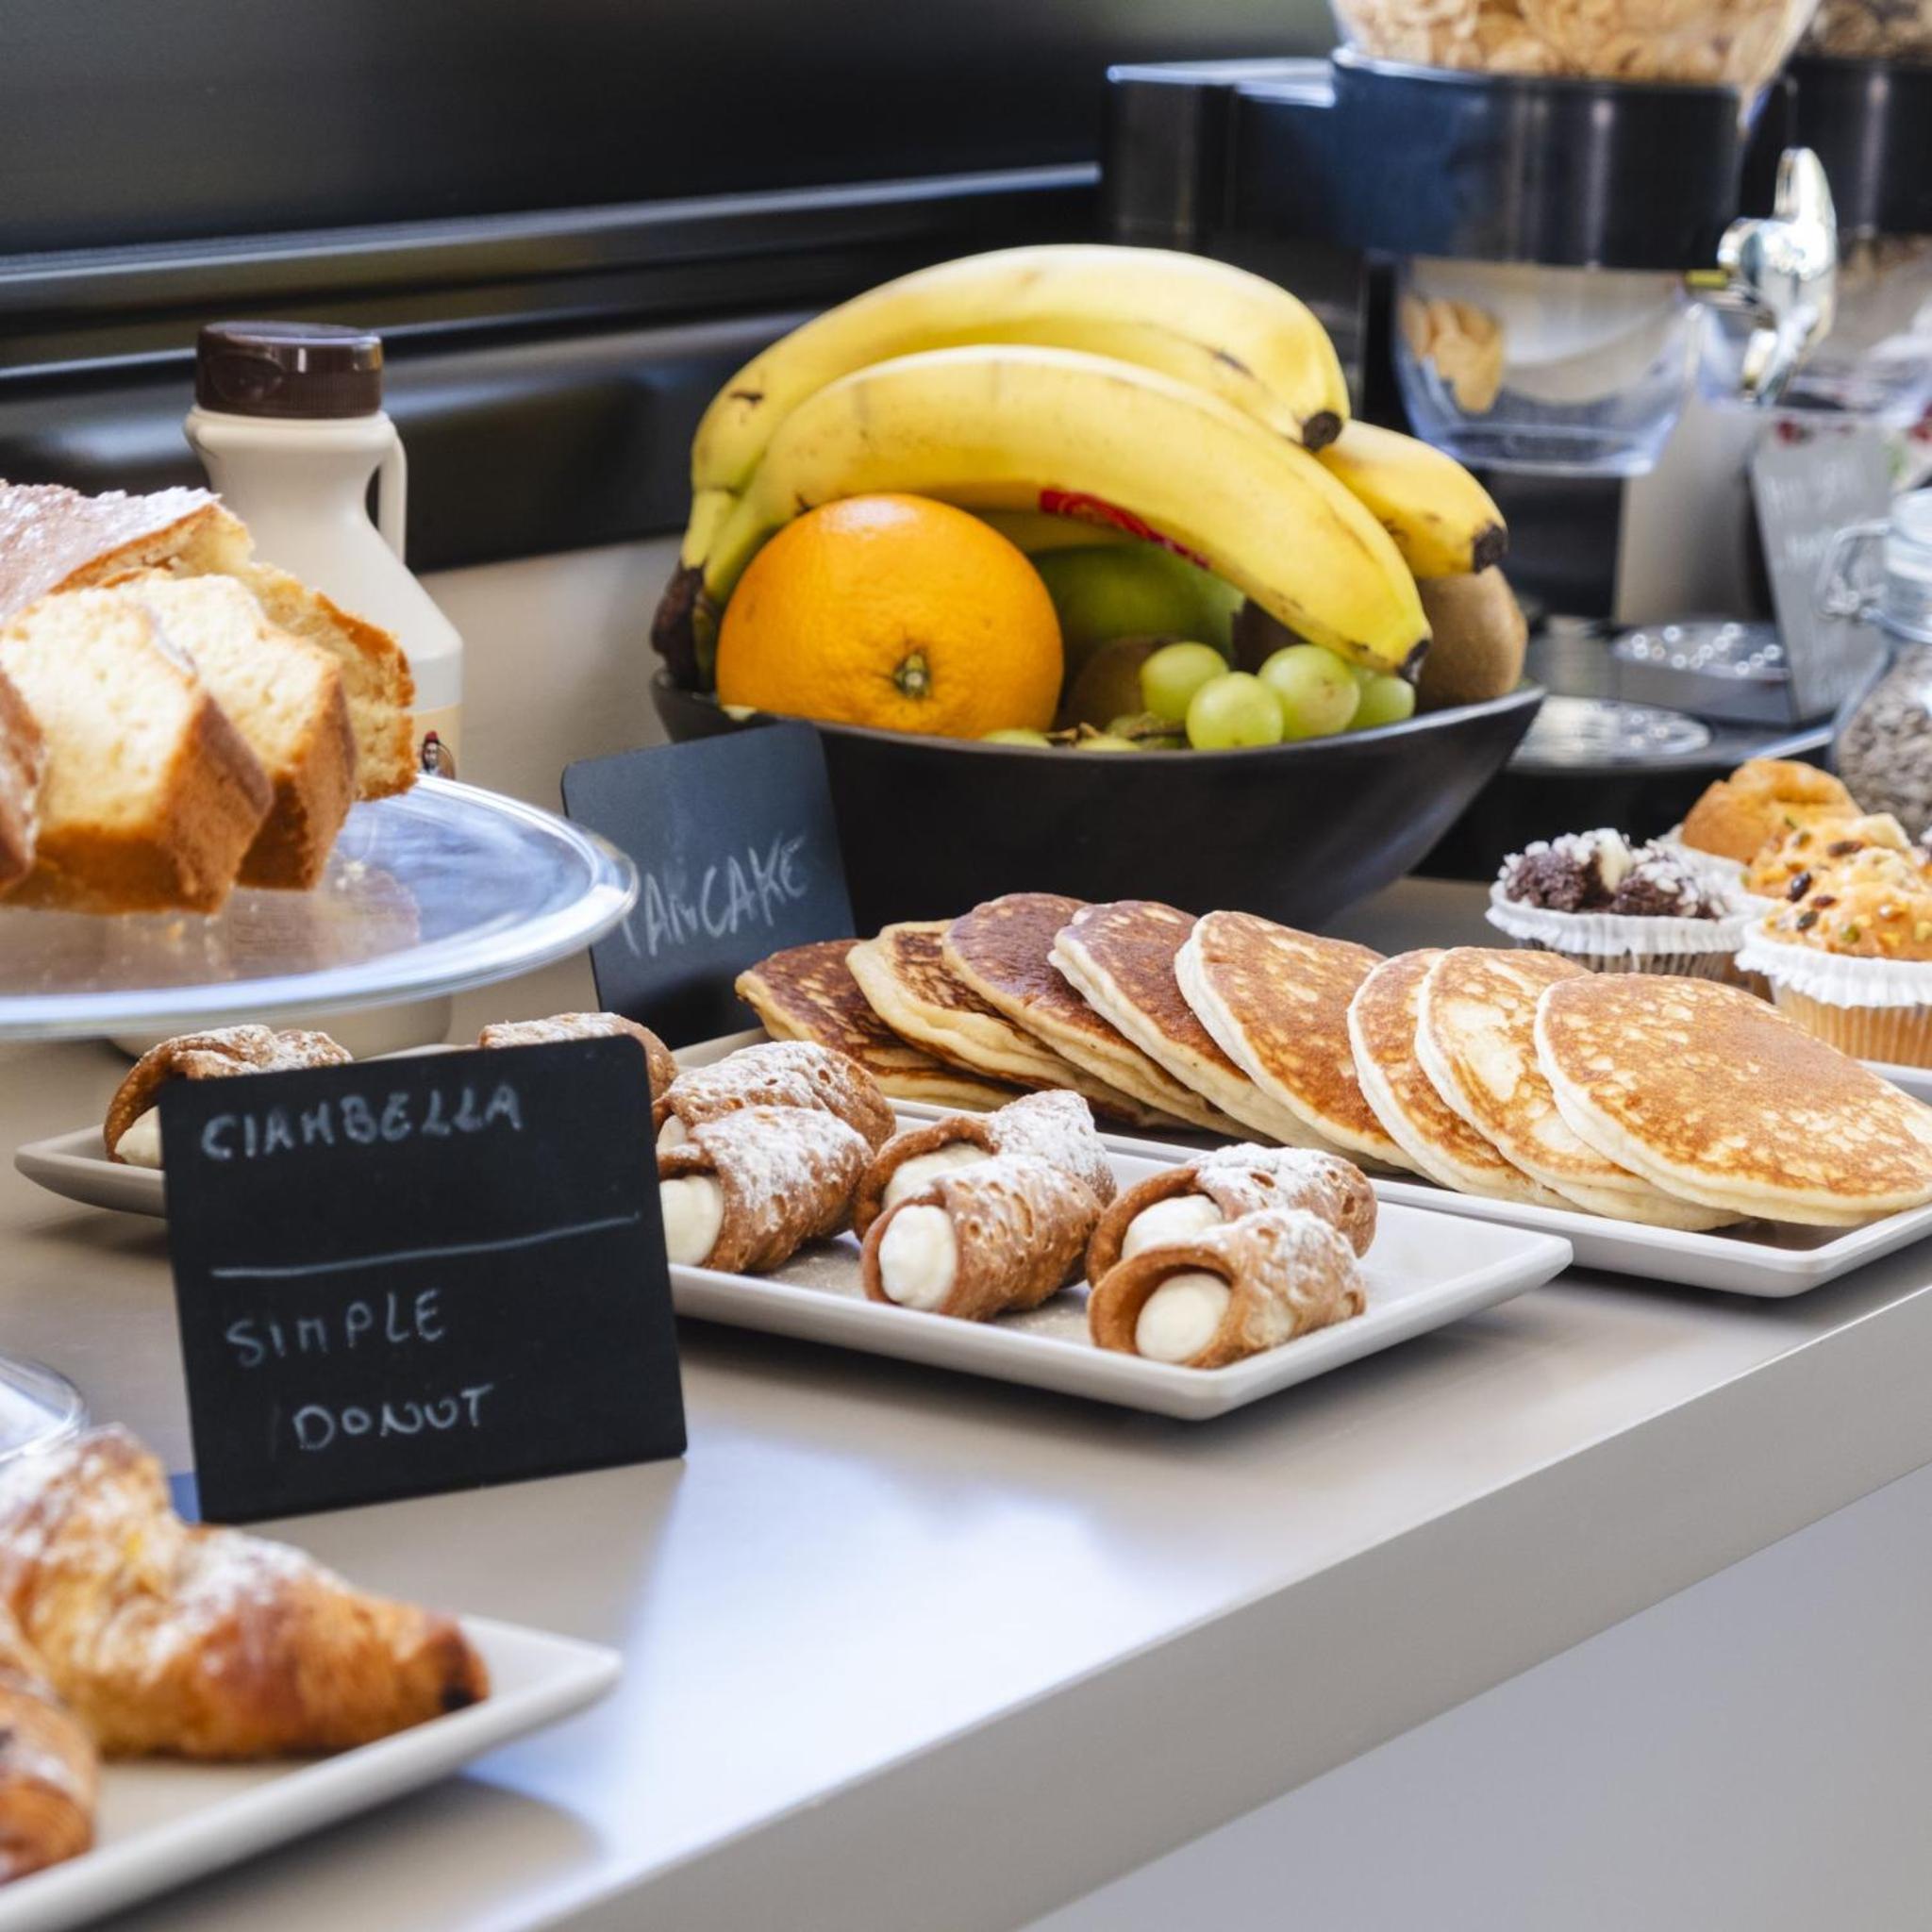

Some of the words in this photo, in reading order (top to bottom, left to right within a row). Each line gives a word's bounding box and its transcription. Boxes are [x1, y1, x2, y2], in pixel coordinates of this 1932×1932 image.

[201, 1084, 523, 1160] CIAMBELLA
[225, 1289, 445, 1367] SIMPLE
[292, 1384, 494, 1450] DONUT
